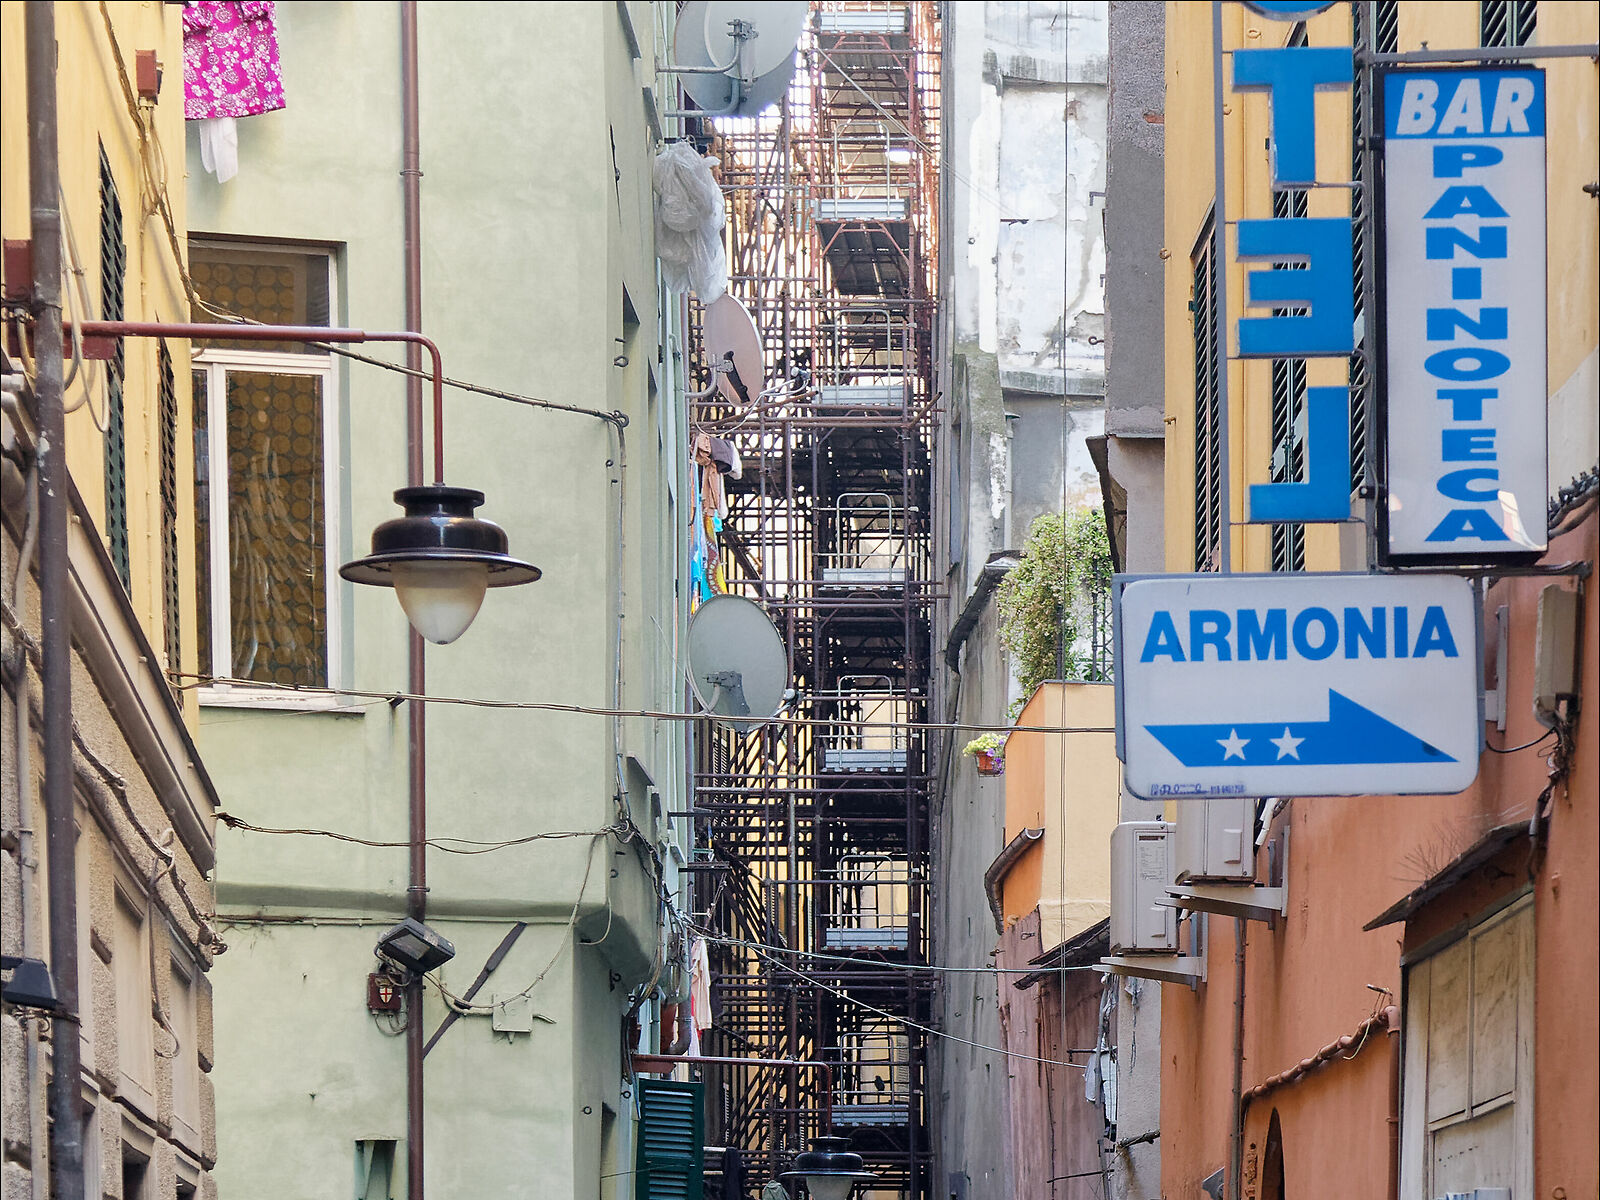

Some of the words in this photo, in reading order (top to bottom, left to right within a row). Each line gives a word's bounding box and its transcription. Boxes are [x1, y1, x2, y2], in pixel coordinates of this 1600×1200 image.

[1396, 77, 1535, 135] BAR
[1422, 145, 1511, 542] PANINOTECA
[1140, 606, 1459, 663] ARMONIA
